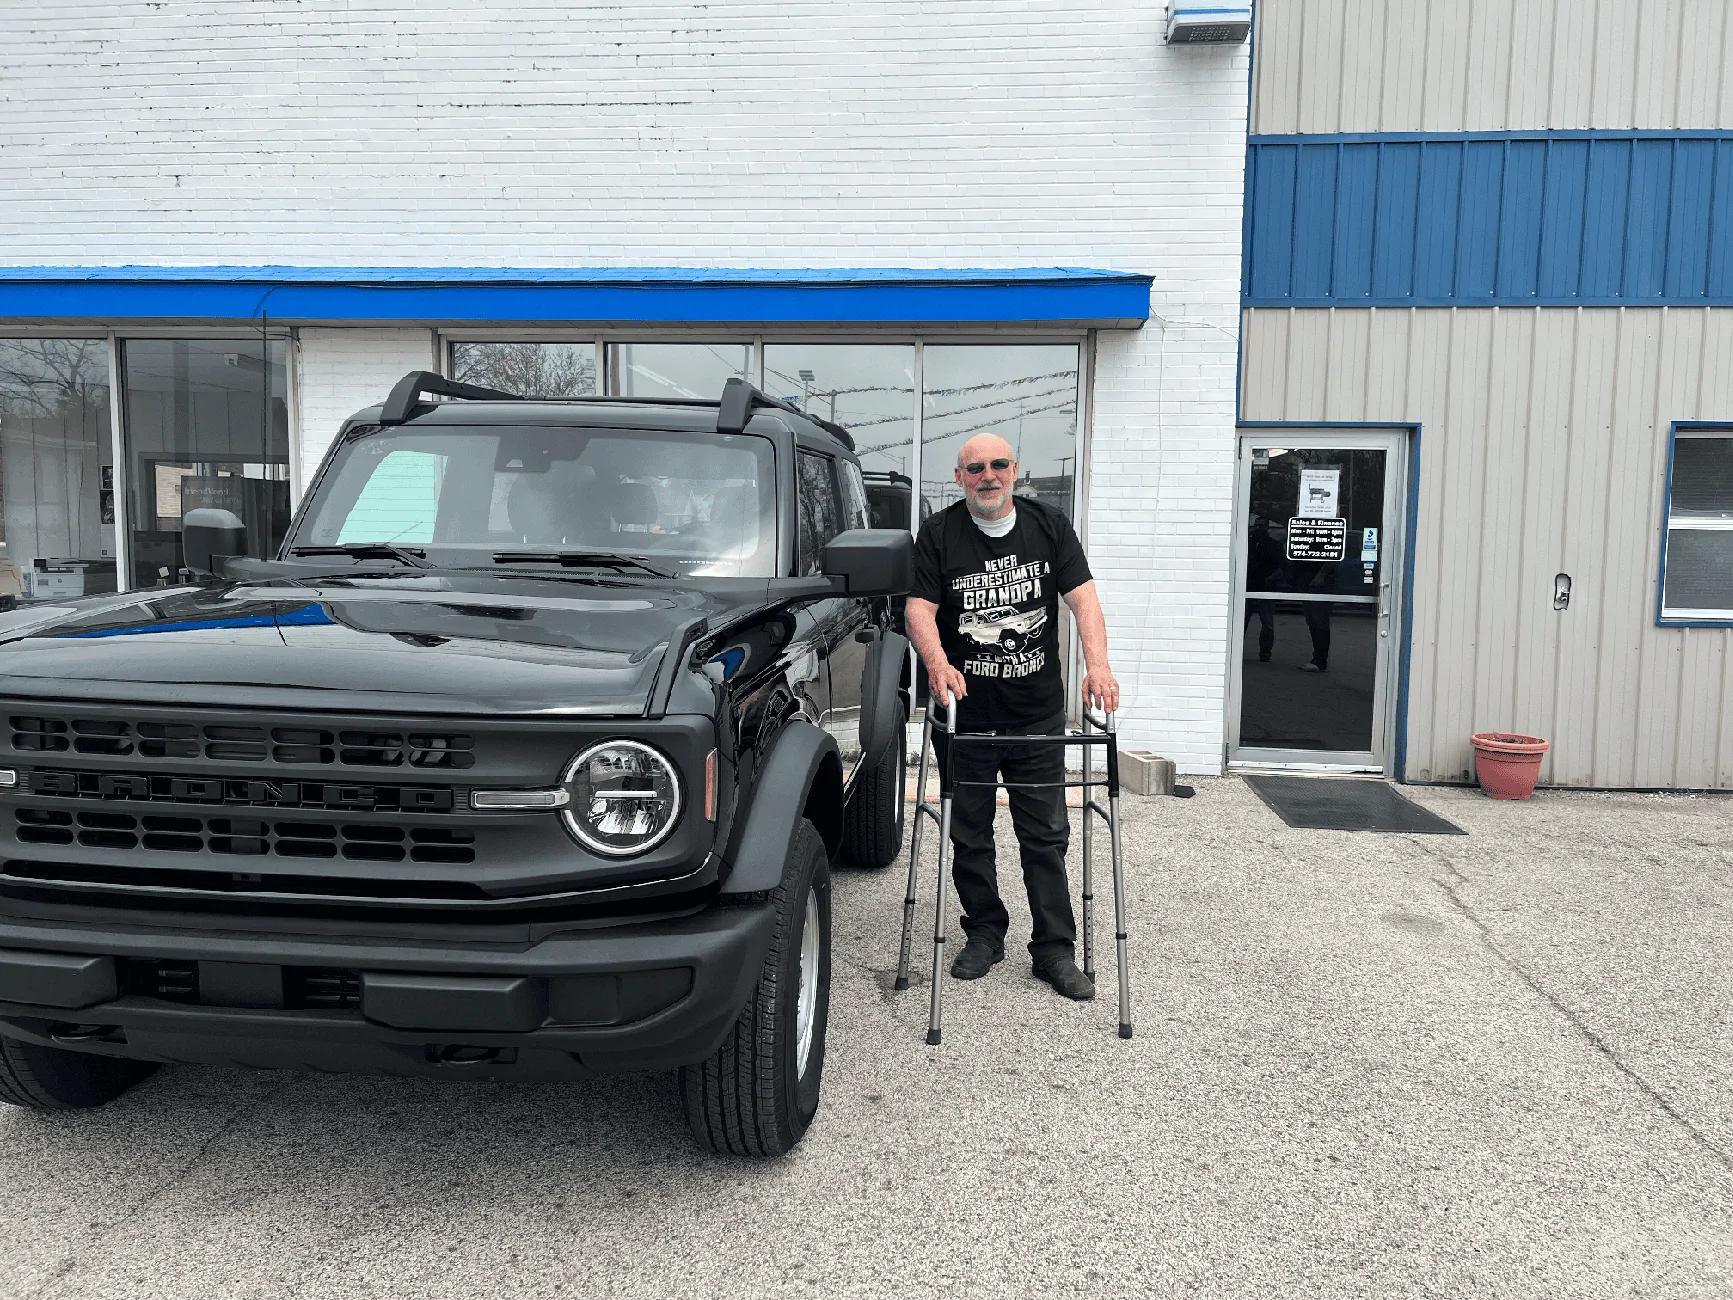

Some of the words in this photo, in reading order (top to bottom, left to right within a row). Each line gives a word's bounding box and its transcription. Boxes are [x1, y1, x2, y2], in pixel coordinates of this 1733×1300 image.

[952, 563, 1040, 590] UNDERESTIMATE
[1043, 561, 1051, 574] A
[984, 554, 1018, 572] NEVER
[963, 579, 1042, 610] GRANDPA
[963, 659, 999, 678] FORD
[28, 770, 455, 811] BRONCO
